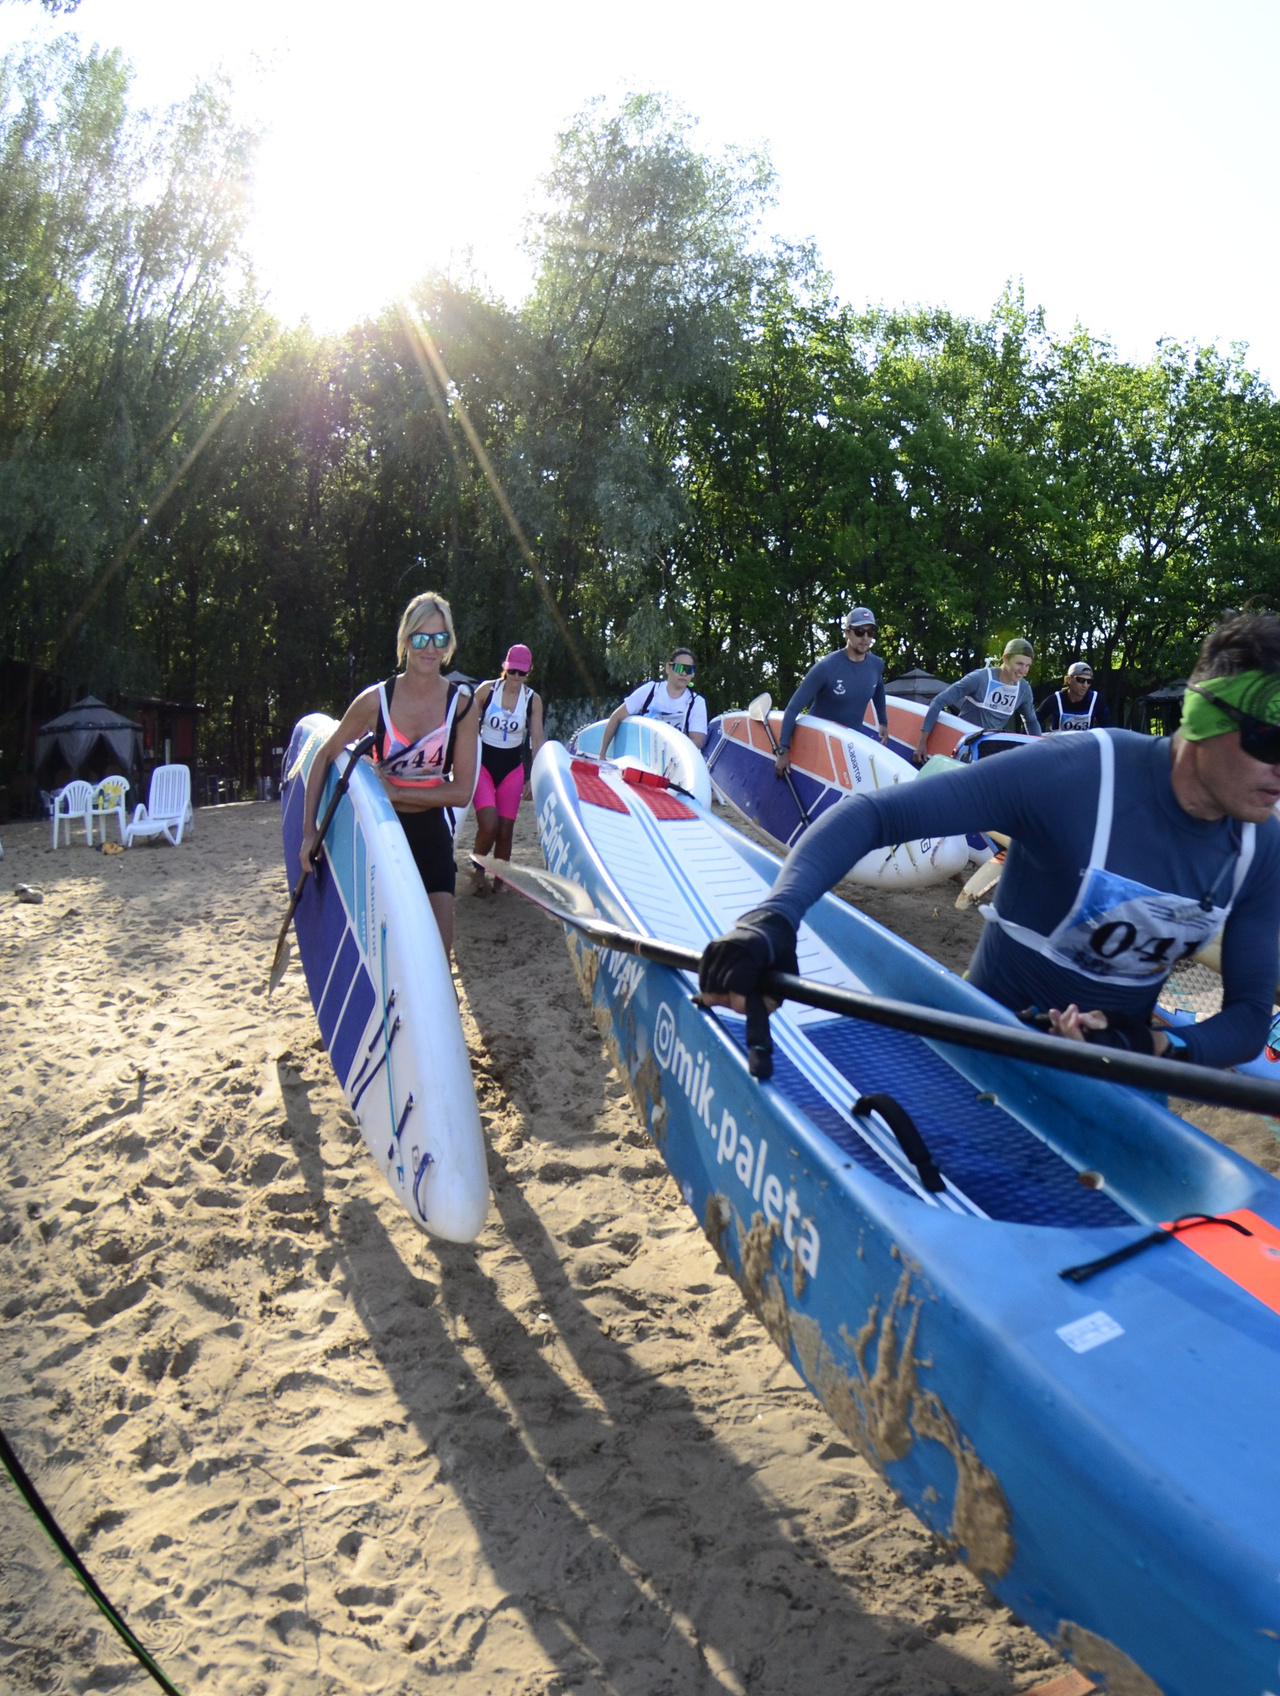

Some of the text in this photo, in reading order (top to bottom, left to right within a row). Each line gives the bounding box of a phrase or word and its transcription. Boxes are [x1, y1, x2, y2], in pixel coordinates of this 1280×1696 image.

[992, 691, 1016, 707] 057
[490, 716, 519, 732] 039
[1063, 721, 1089, 731] 063
